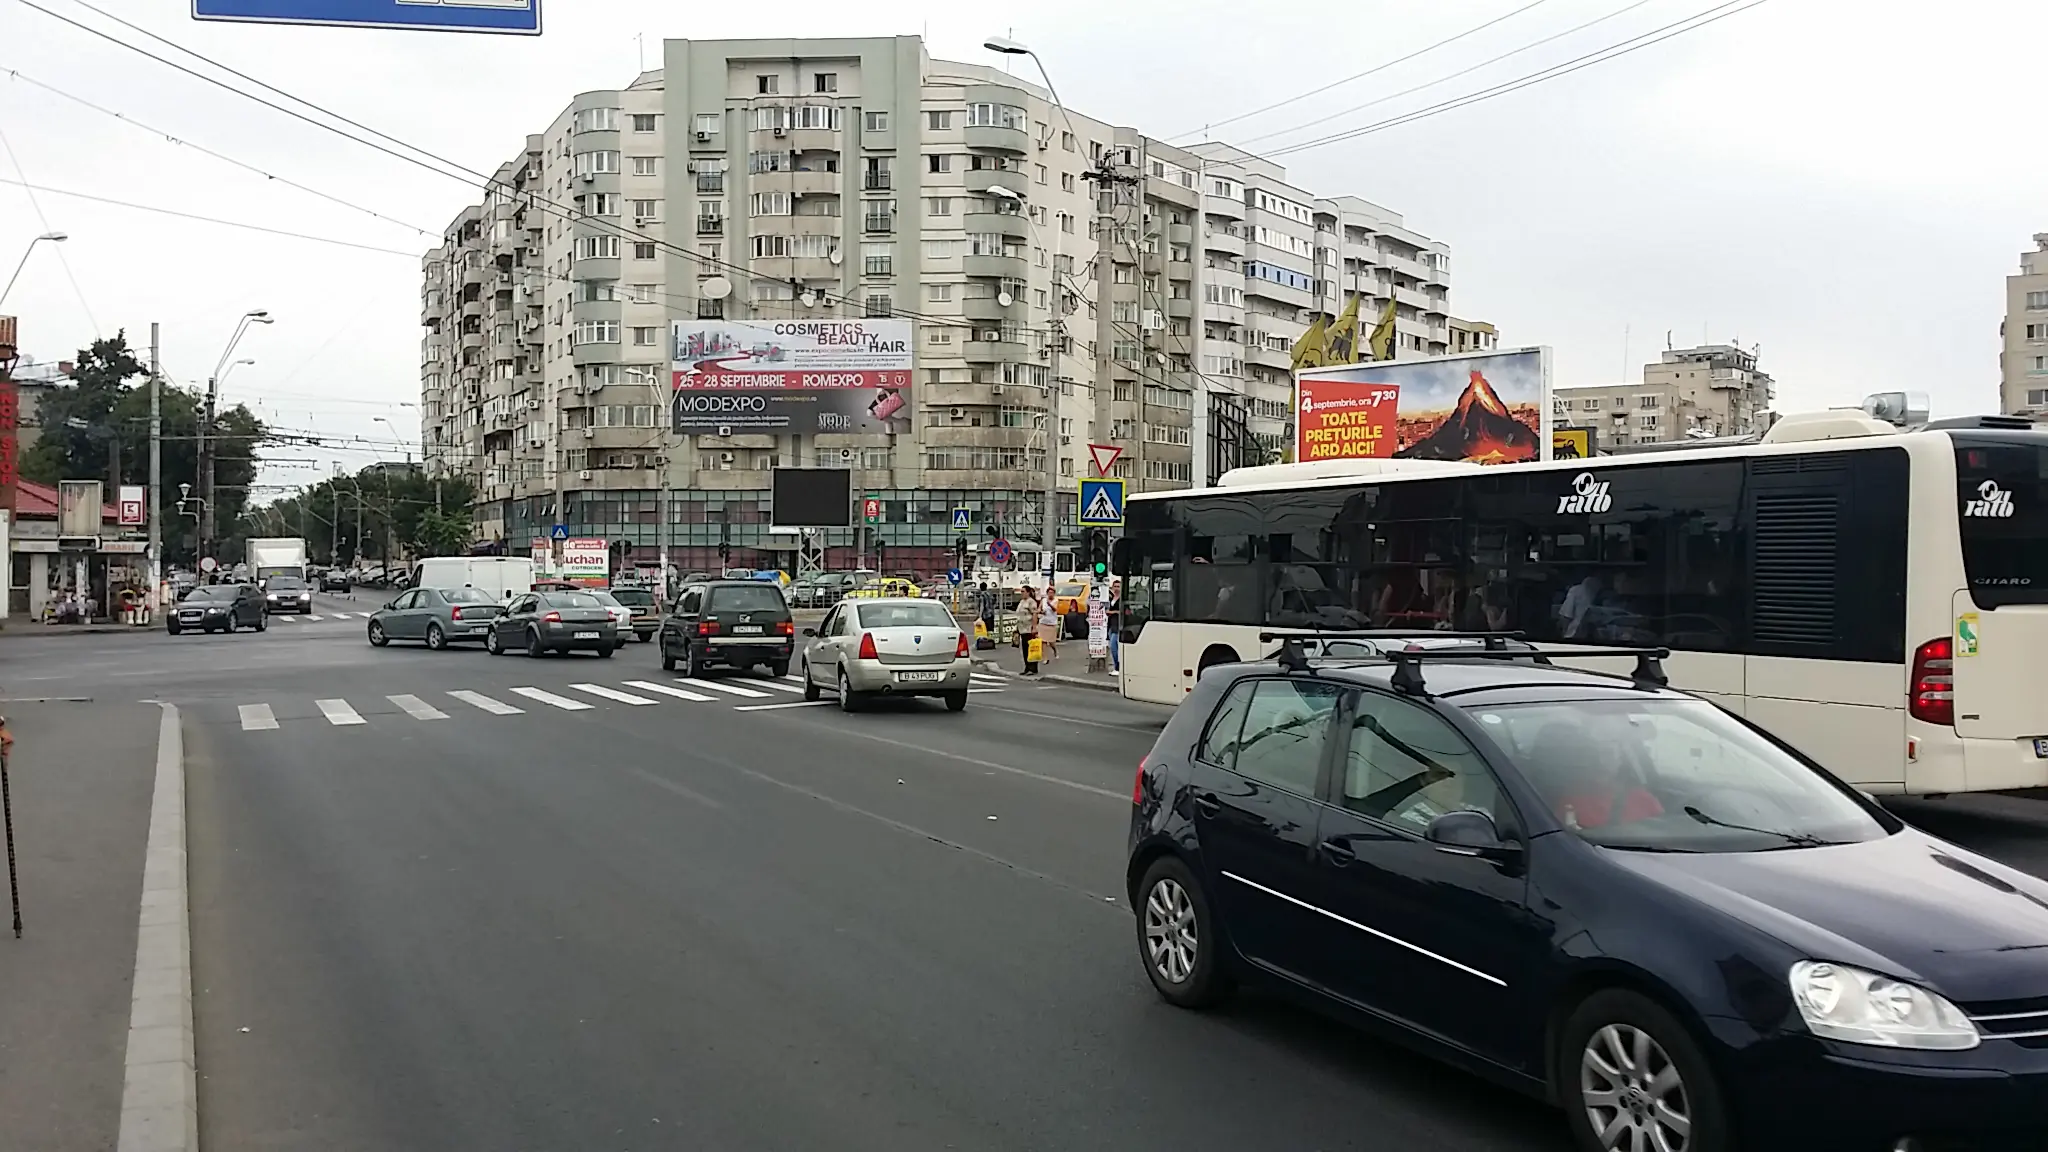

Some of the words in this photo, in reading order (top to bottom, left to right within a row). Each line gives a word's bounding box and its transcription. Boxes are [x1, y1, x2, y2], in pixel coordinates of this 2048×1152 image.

[774, 323, 864, 335] COSMETICS
[817, 333, 880, 345] BEAUTY
[869, 341, 906, 353] HAIR
[680, 375, 694, 387] 25
[704, 374, 718, 387] 28
[720, 374, 786, 387] SEPTEMBRIE
[803, 373, 864, 387] ROMEXPO
[679, 396, 766, 412] MODEXPO
[1301, 397, 1313, 413] 4
[1313, 397, 1358, 410] septembrie,
[1358, 397, 1372, 406] ora
[1320, 411, 1368, 426] TOATE
[1310, 444, 1340, 457] ARD
[1342, 441, 1375, 456] AICI!
[559, 554, 604, 565] uchan
[1974, 577, 2031, 585] CITARO
